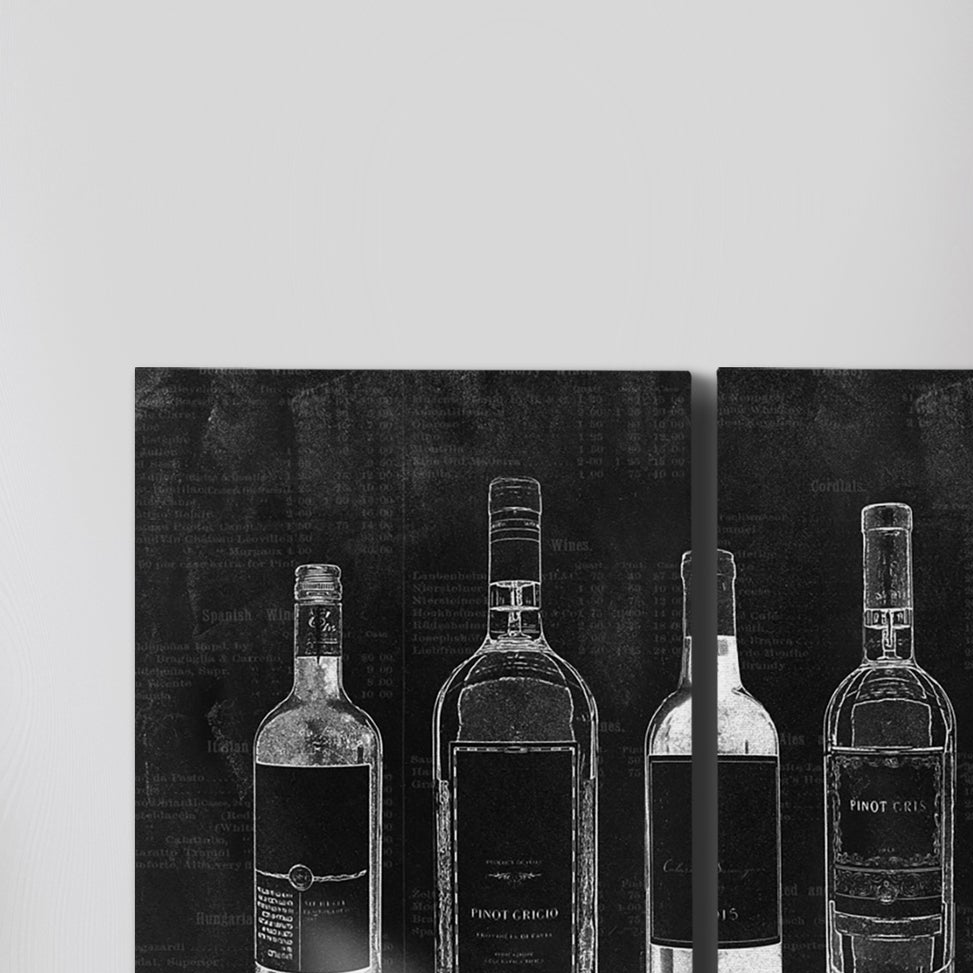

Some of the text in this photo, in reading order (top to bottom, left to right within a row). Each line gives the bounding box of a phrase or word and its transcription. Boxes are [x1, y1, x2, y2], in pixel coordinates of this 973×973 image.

[551, 539, 593, 552] Wines.
[202, 607, 251, 625] Spanish
[850, 800, 927, 813] PINOT GRIS
[471, 907, 559, 921] PINOT GRIGIO
